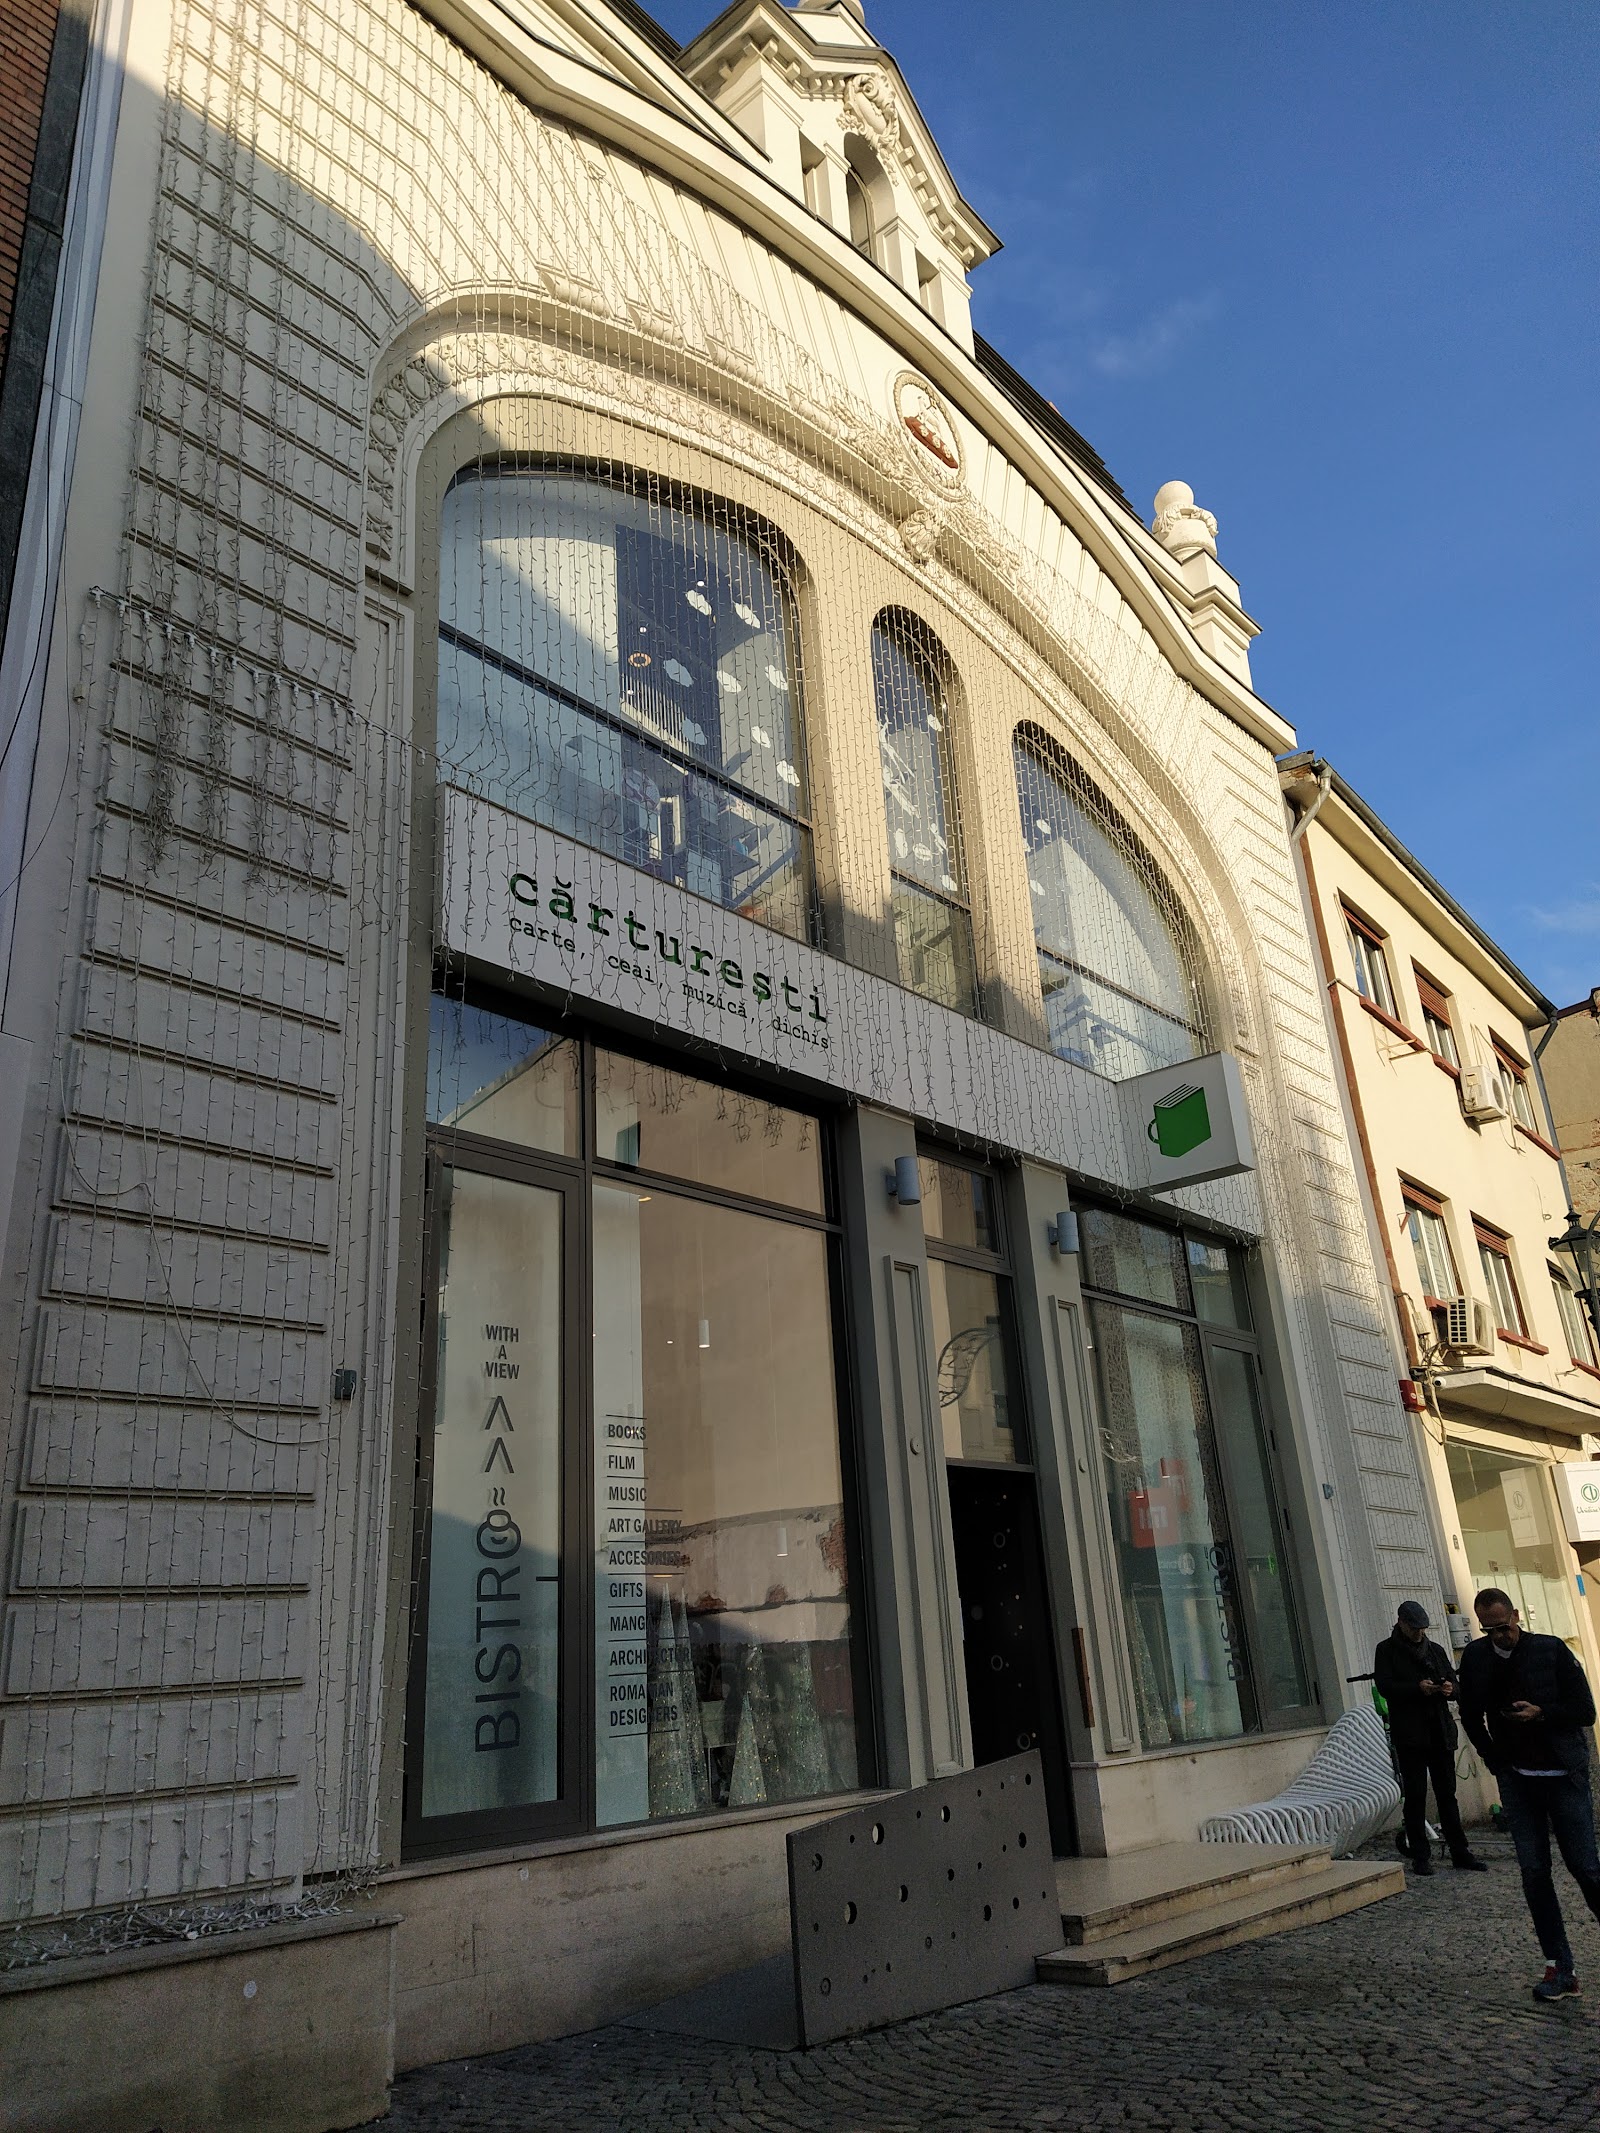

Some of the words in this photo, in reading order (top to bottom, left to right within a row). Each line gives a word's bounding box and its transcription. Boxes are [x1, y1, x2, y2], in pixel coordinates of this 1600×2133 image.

[509, 917, 585, 960] carte,
[607, 955, 664, 990] ceai,
[682, 983, 755, 1024] muzică,
[772, 1015, 829, 1049] dichis
[485, 1324, 519, 1342] WITH
[498, 1345, 507, 1360] A
[485, 1362, 520, 1379] VIEW
[608, 1424, 646, 1440] BOOKS
[608, 1455, 635, 1470] FILM
[608, 1486, 647, 1501] MUSIC
[608, 1518, 630, 1533] ART
[609, 1583, 643, 1598] GIFTS
[474, 1511, 522, 1752] BISTRO
[610, 1615, 650, 1632] MANG
